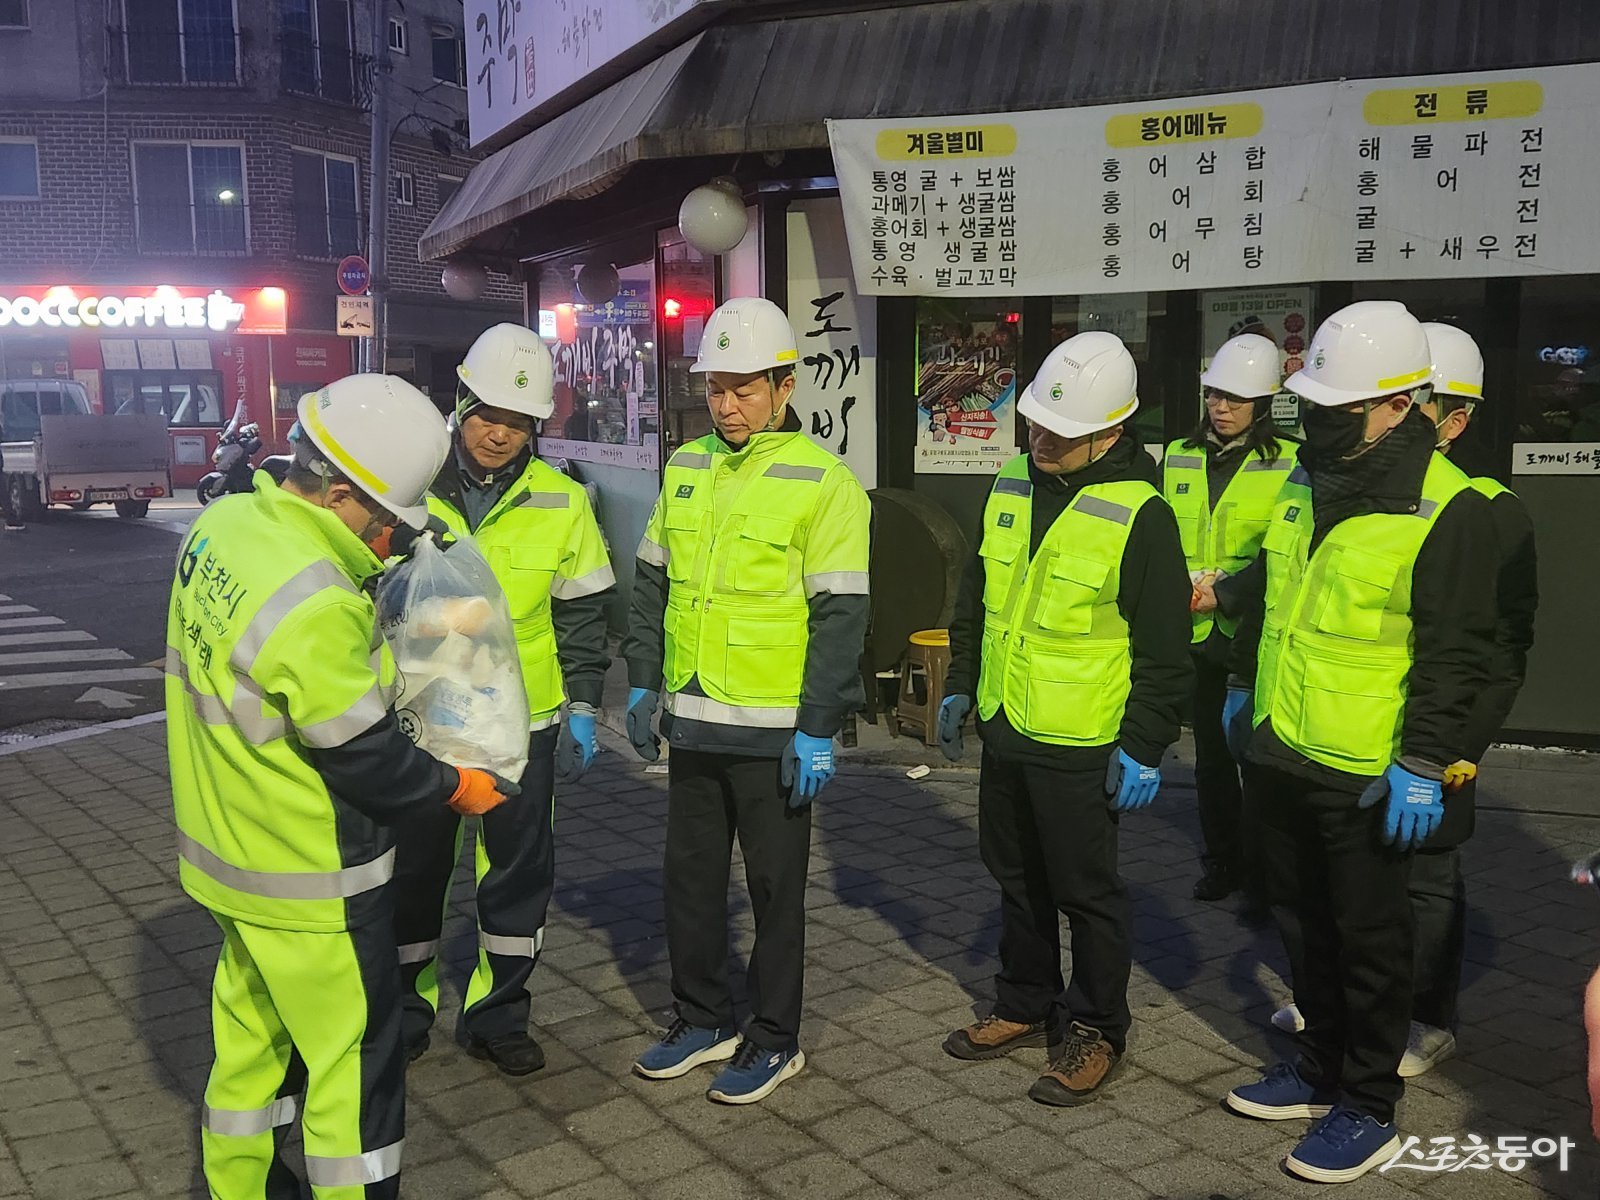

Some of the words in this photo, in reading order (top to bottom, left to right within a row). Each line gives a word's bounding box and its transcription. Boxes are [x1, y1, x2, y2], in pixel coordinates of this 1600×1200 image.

[1141, 112, 1227, 141] 홍어메뉴
[907, 131, 984, 156] 겨울별미
[872, 170, 907, 193] 통영
[920, 170, 938, 192] 굴
[976, 166, 1017, 189] 보쌈
[872, 194, 927, 216] 과메기
[958, 191, 1017, 215] 생굴쌈
[871, 216, 928, 240] 홍어회
[959, 215, 1017, 240] 생굴쌈
[871, 266, 909, 288] 수육
[936, 266, 1018, 288] 벌교꼬막
[341, 301, 370, 310] 견인지역
[1267, 299, 1302, 309] OPEN
[804, 291, 860, 455] 도깨비
[1526, 452, 1571, 466] 도깨비
[199, 551, 247, 620] 부천시
[210, 615, 229, 636] City
